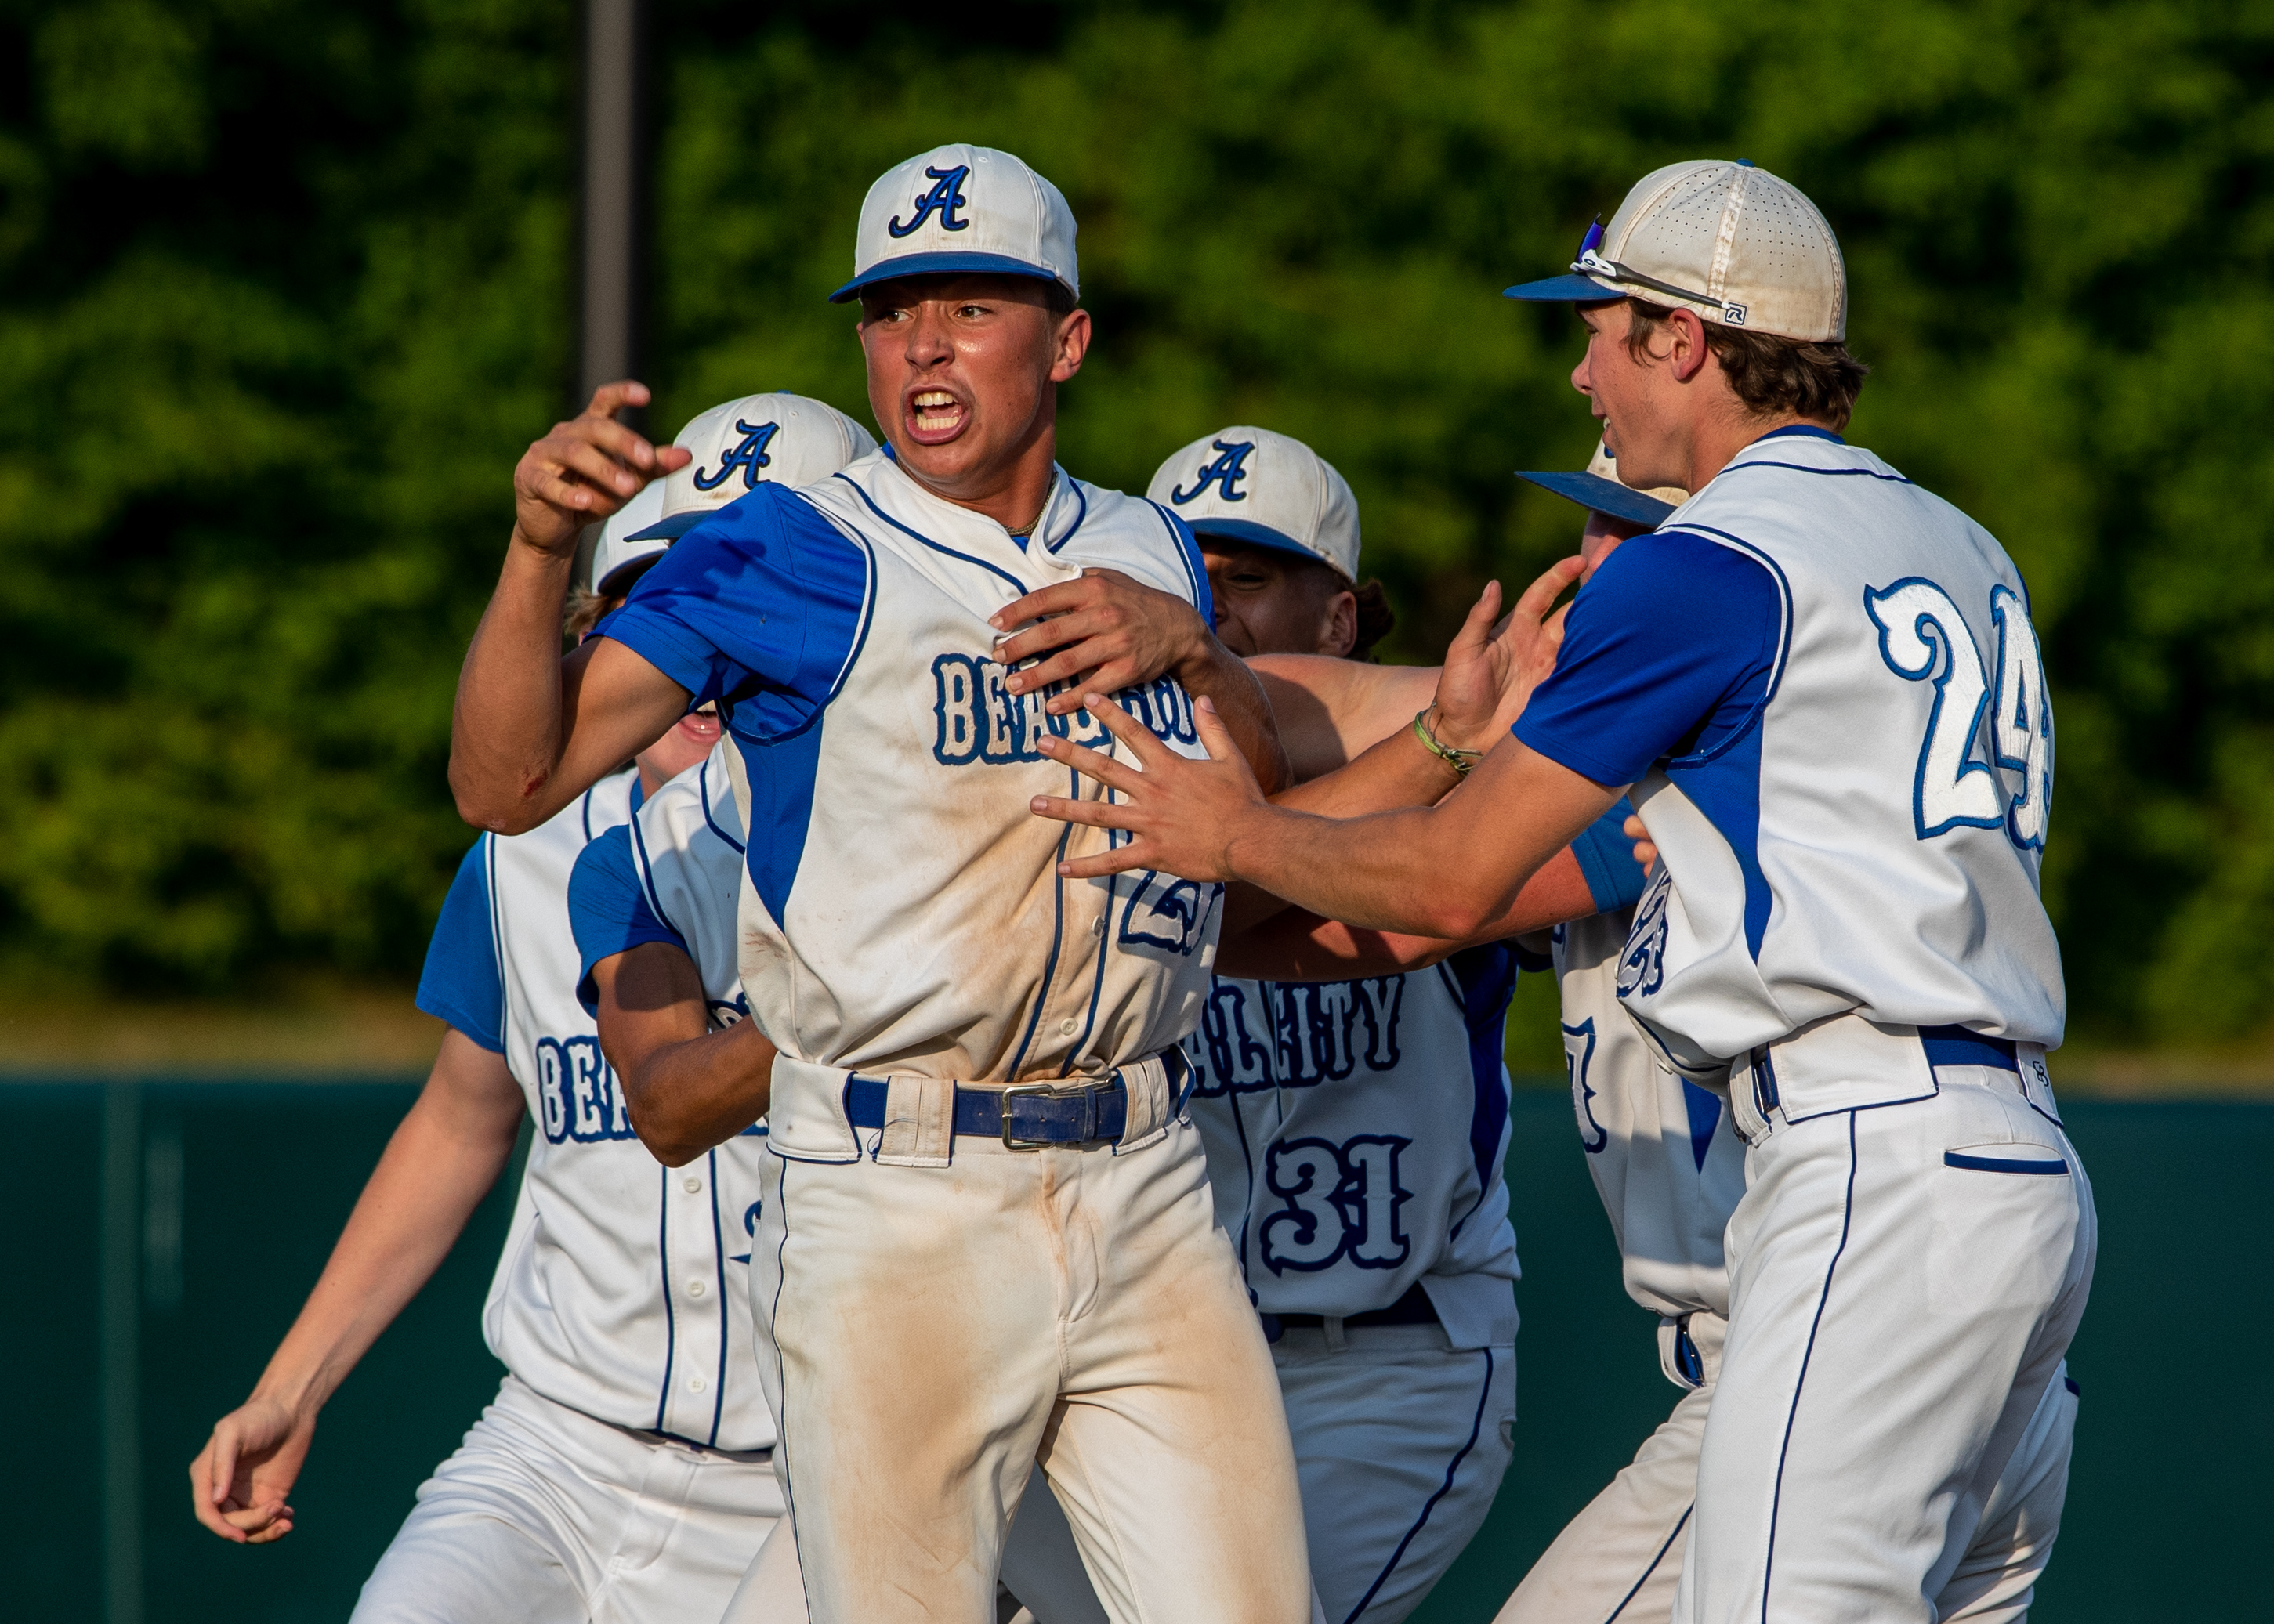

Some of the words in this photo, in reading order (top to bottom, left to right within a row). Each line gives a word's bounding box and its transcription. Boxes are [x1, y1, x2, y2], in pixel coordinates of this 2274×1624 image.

[888, 164, 970, 238] A
[693, 418, 780, 491] A
[1171, 439, 1256, 505] A
[1863, 576, 2052, 855] 24
[1260, 1134, 1414, 1277] 31
